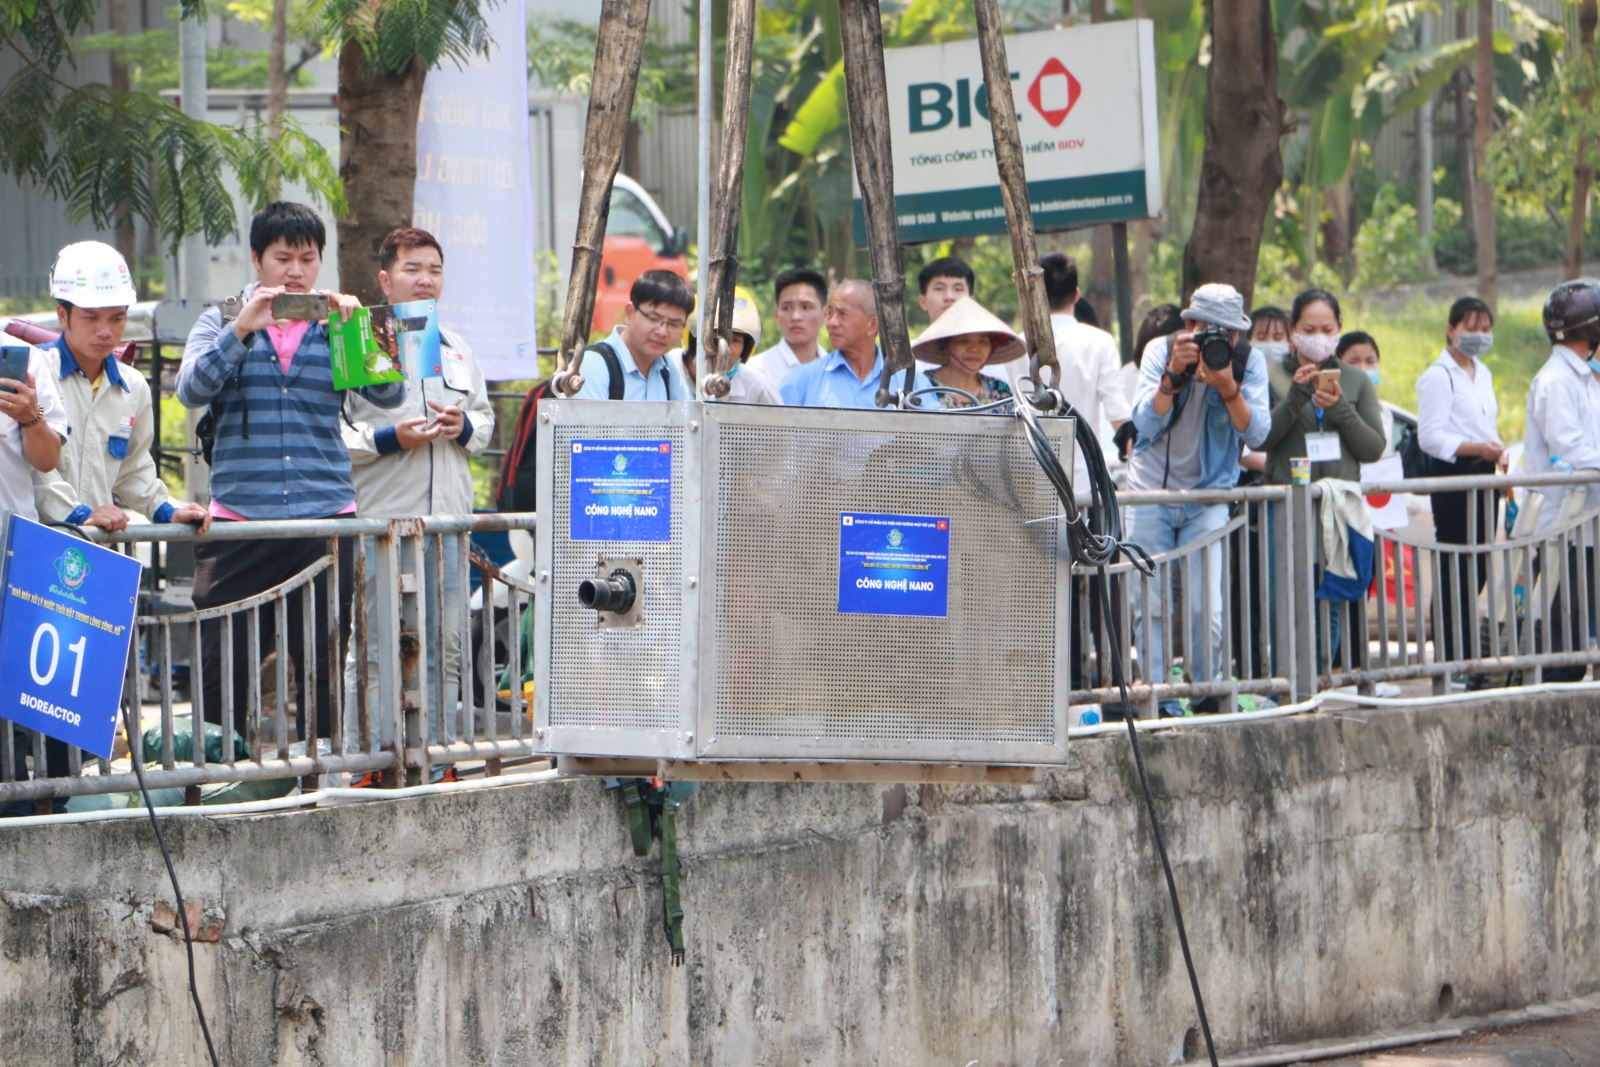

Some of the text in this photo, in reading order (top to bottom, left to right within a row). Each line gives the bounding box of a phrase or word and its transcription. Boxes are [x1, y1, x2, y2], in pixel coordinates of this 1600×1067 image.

[1057, 137, 1085, 151] BIDV
[585, 503, 658, 518] CÔNG NGHỆ NANO
[856, 577, 934, 593] CÔNG NGHỆ NANO
[29, 622, 87, 698] 01
[20, 692, 81, 727] BIOREACTOR
